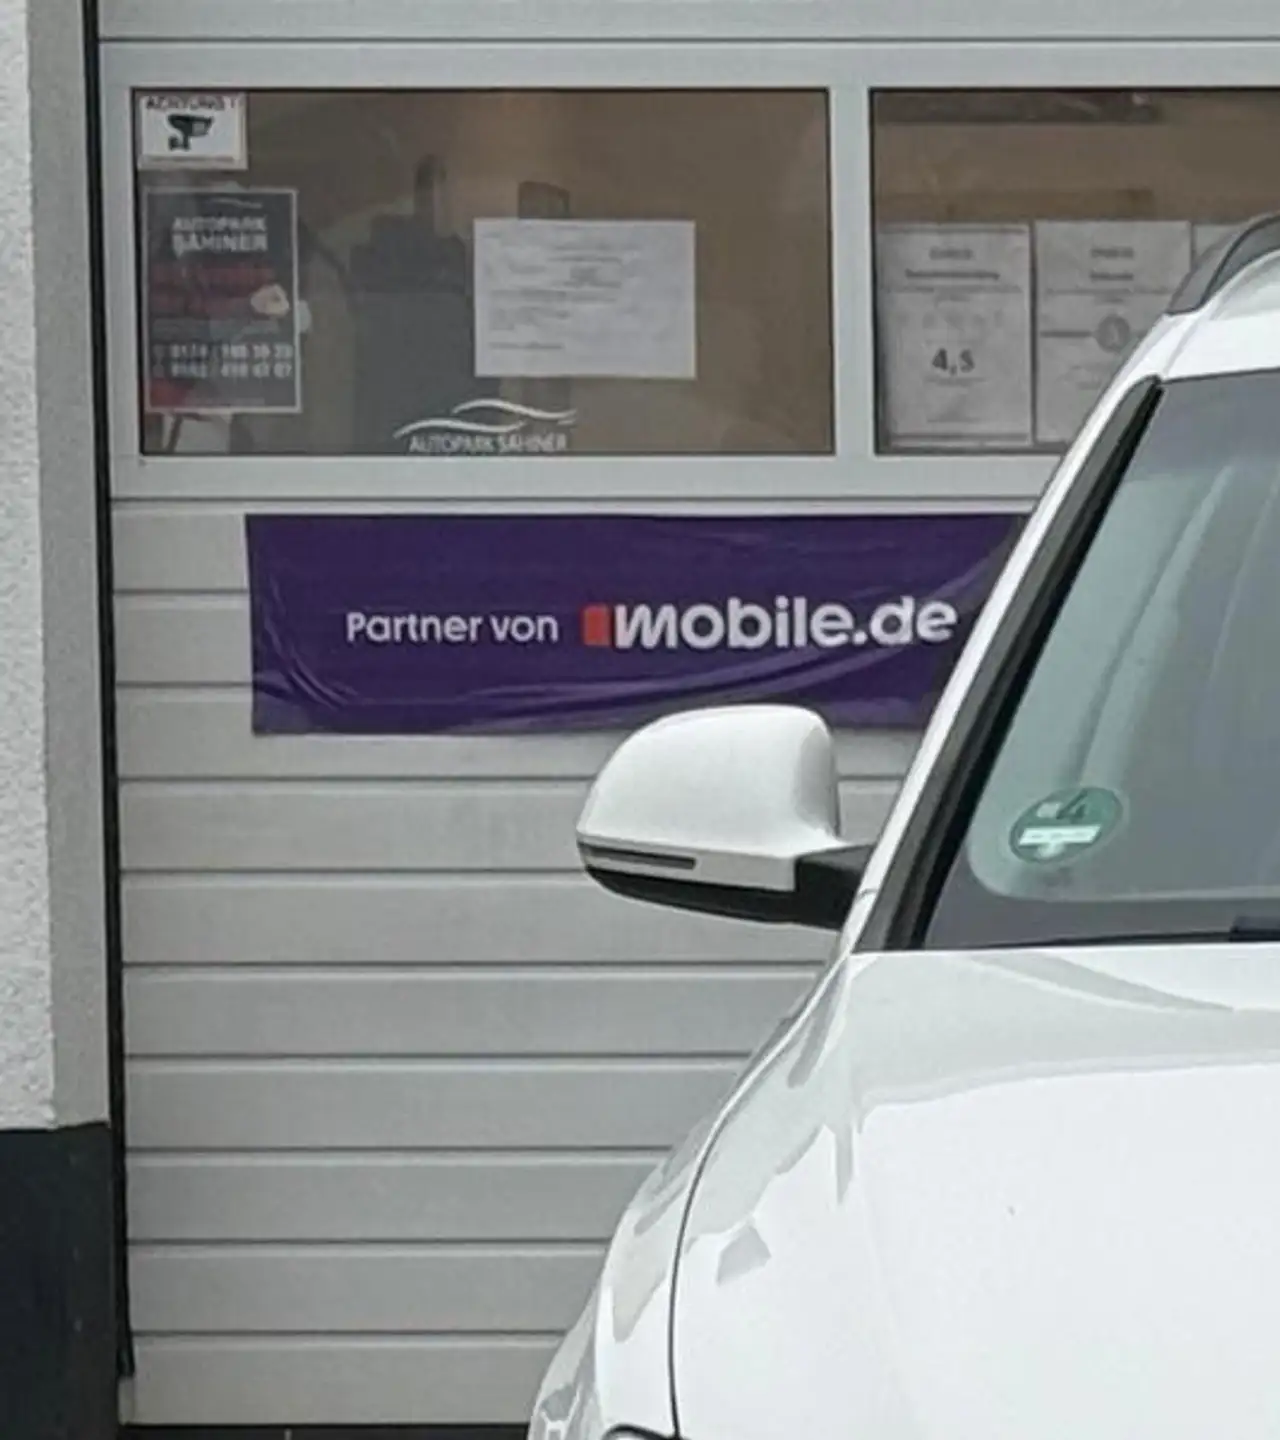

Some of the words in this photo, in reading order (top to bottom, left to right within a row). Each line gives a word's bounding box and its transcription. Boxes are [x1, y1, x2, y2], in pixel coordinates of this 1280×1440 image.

[931, 347, 976, 376] 4,5
[408, 433, 495, 453] AUTOPARK
[346, 611, 483, 643] Partner
[489, 614, 559, 643] von
[613, 596, 957, 649] mobile.de
